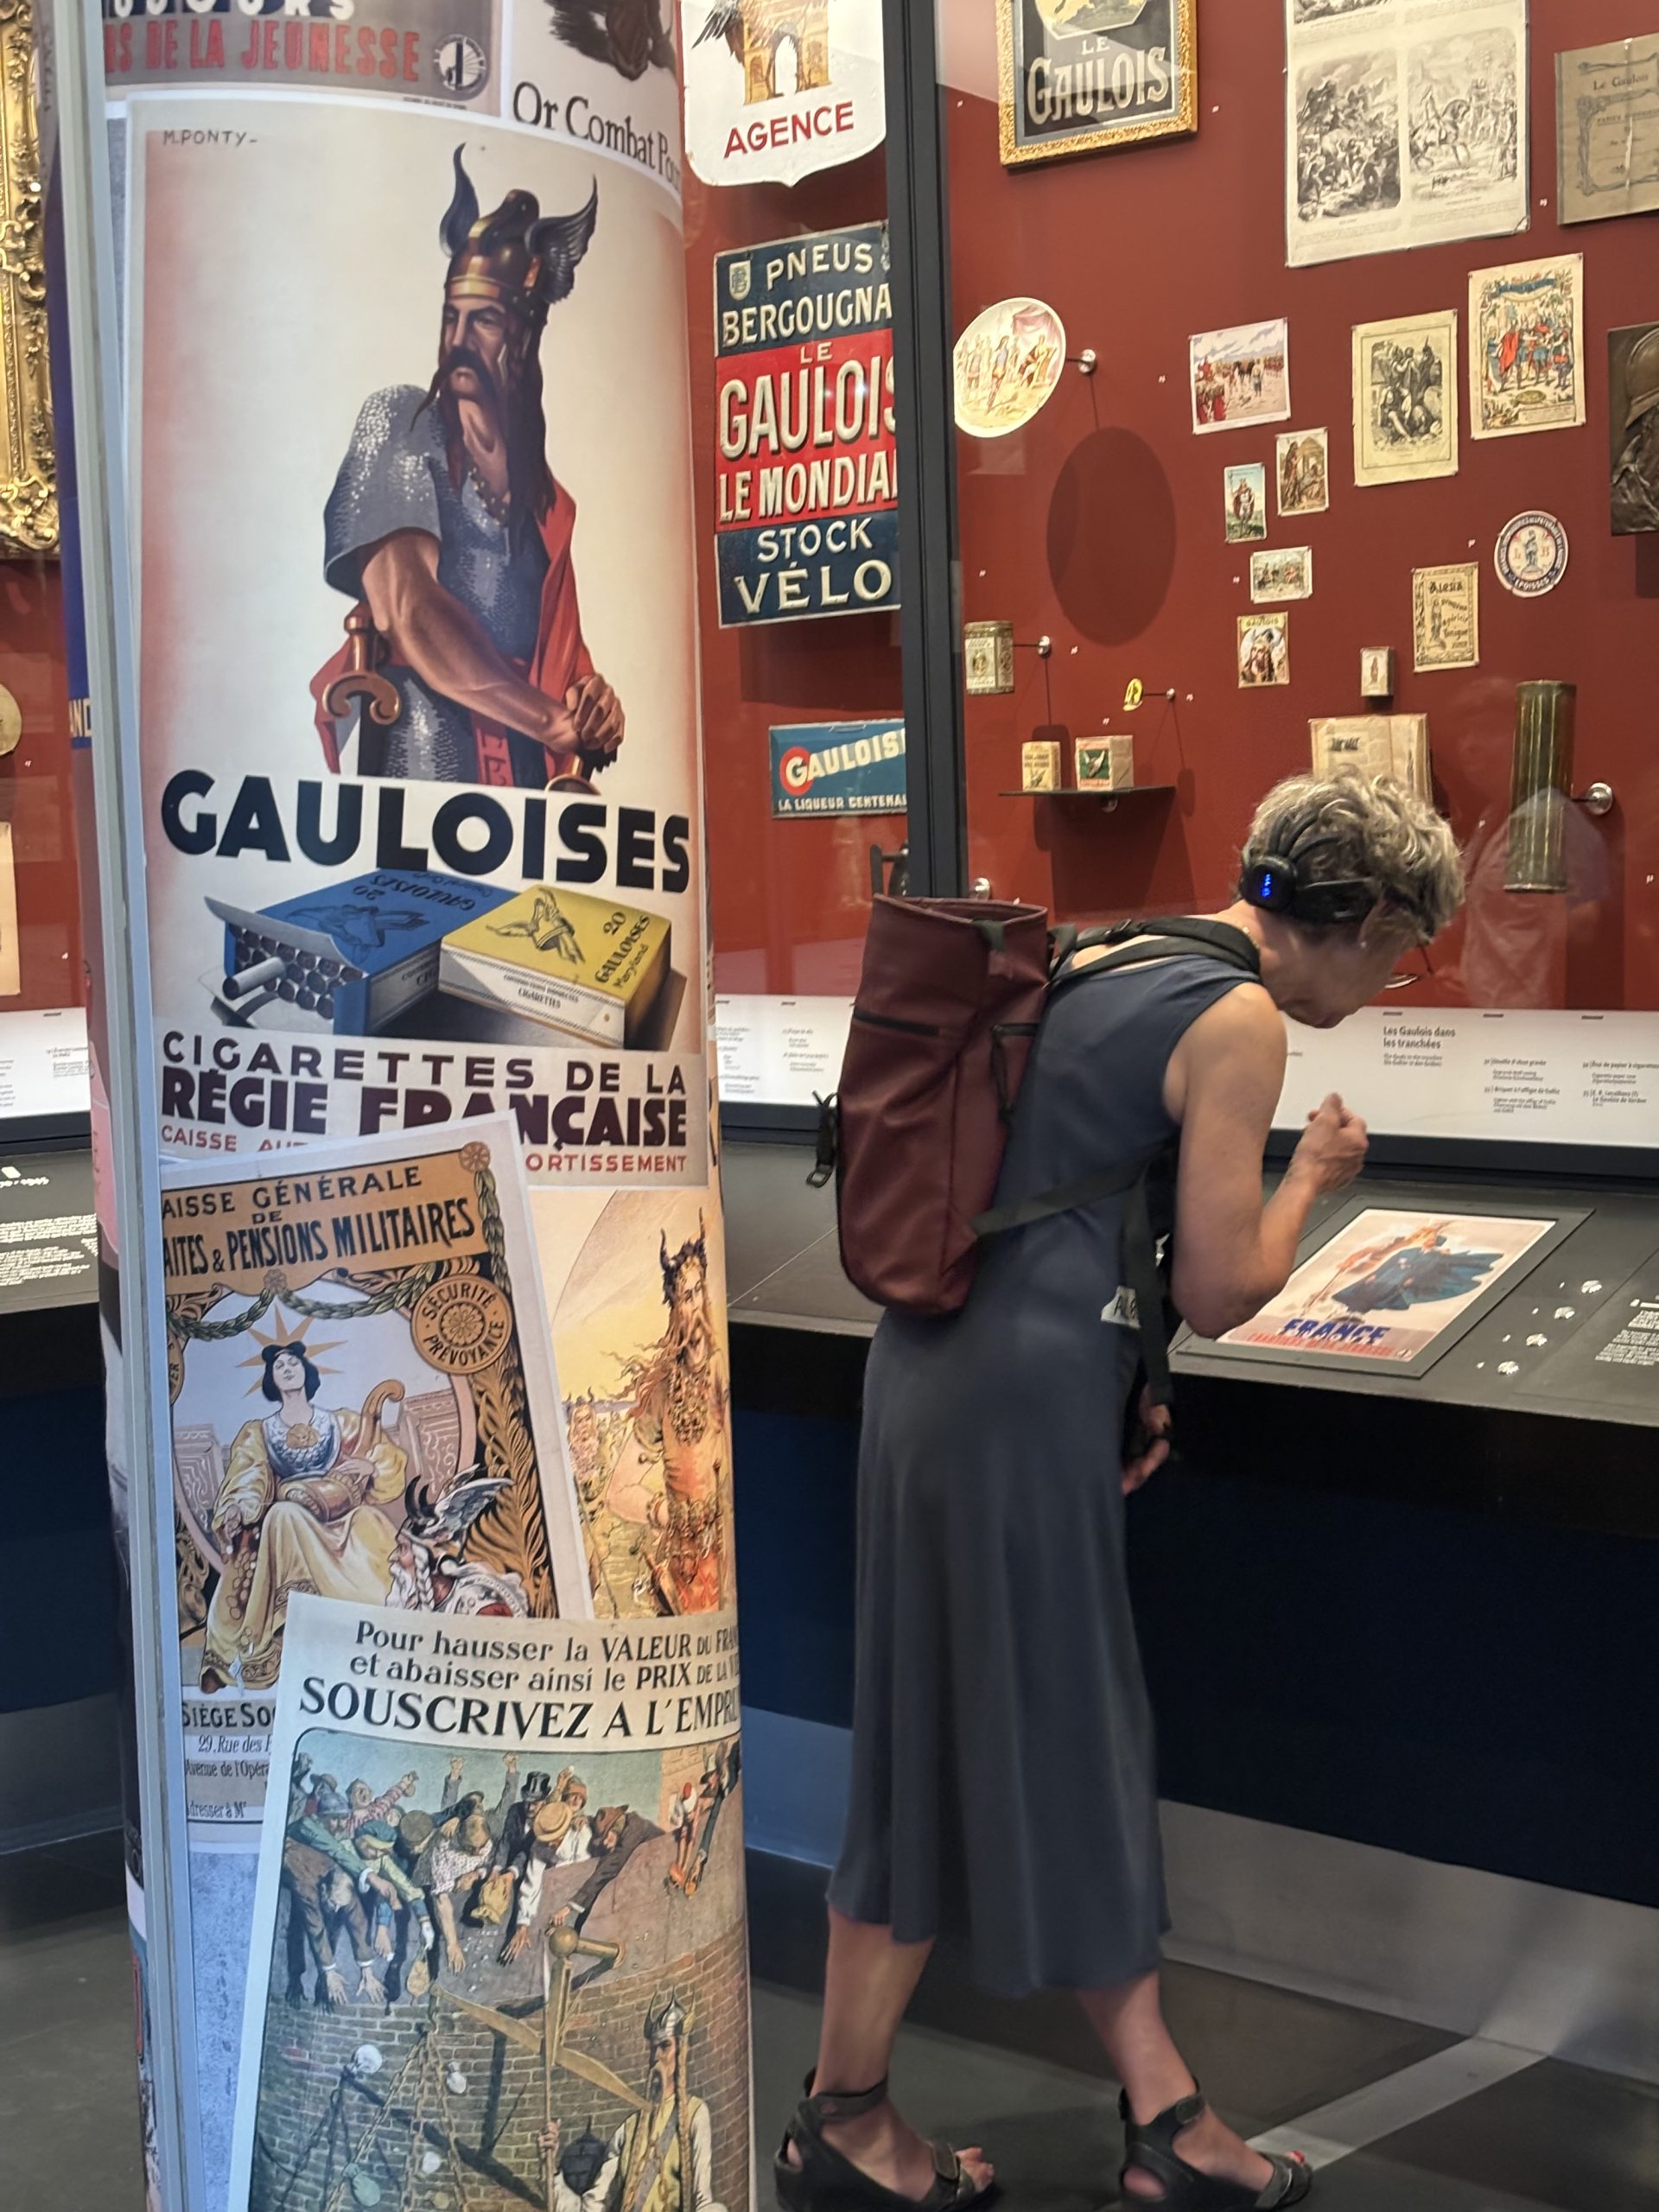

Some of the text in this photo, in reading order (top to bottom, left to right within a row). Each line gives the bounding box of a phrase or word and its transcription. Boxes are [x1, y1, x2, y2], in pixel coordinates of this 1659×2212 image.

[146, 20, 178, 69] DE
[190, 19, 225, 69] LA
[241, 19, 419, 82] JEUNESSE
[1081, 36, 1110, 57] LE
[1027, 46, 1170, 125] GAULOIS
[513, 81, 558, 130] Or
[566, 96, 654, 170] Combat
[724, 100, 855, 160] AGENCE
[766, 242, 874, 291] PNEUS
[721, 283, 893, 347] BERGOUGNA
[800, 341, 833, 364] LE
[719, 449, 897, 524] LE MONDIA
[756, 516, 874, 563] STOCK
[734, 557, 893, 615] VÉLO
[794, 796, 845, 811] LIQUEUR
[161, 768, 691, 894] GAULOISES
[353, 884, 387, 901] 20
[603, 911, 626, 936] 20
[594, 913, 650, 984] GAULOISES
[1399, 1026, 1433, 1037] Gaulois
[1434, 1026, 1457, 1037] dans
[162, 1031, 688, 1096] CIGARETTES DE LA
[162, 1058, 328, 1135] RÉGIE
[161, 1125, 238, 1153] CAISSE
[252, 1165, 423, 1209] GÉNÉRALE
[213, 1248, 226, 1274] &
[226, 1219, 328, 1272] PENSIONS
[334, 1196, 477, 1258] MILITAIRES
[251, 1210, 283, 1225] DE
[1281, 1318, 1392, 1346] FRANCE
[356, 1620, 424, 1652] Pour
[433, 1630, 553, 1662] hausser
[565, 1636, 588, 1662] la
[602, 1632, 692, 1663] VALEUR
[696, 1633, 714, 1656] DU
[349, 1651, 380, 1678] et
[386, 1659, 519, 1691] abaisser
[528, 1667, 592, 1694] ainsi
[604, 1667, 626, 1694] le
[635, 1662, 691, 1691] PRIX
[696, 1663, 713, 1686] DE
[299, 1675, 594, 1739] SOUSCRIVEZ
[601, 1703, 634, 1738] A
[218, 1735, 239, 1753] Rue
[242, 1735, 264, 1752] des
[220, 1761, 233, 1777] de
[188, 1801, 226, 1819] dresser
